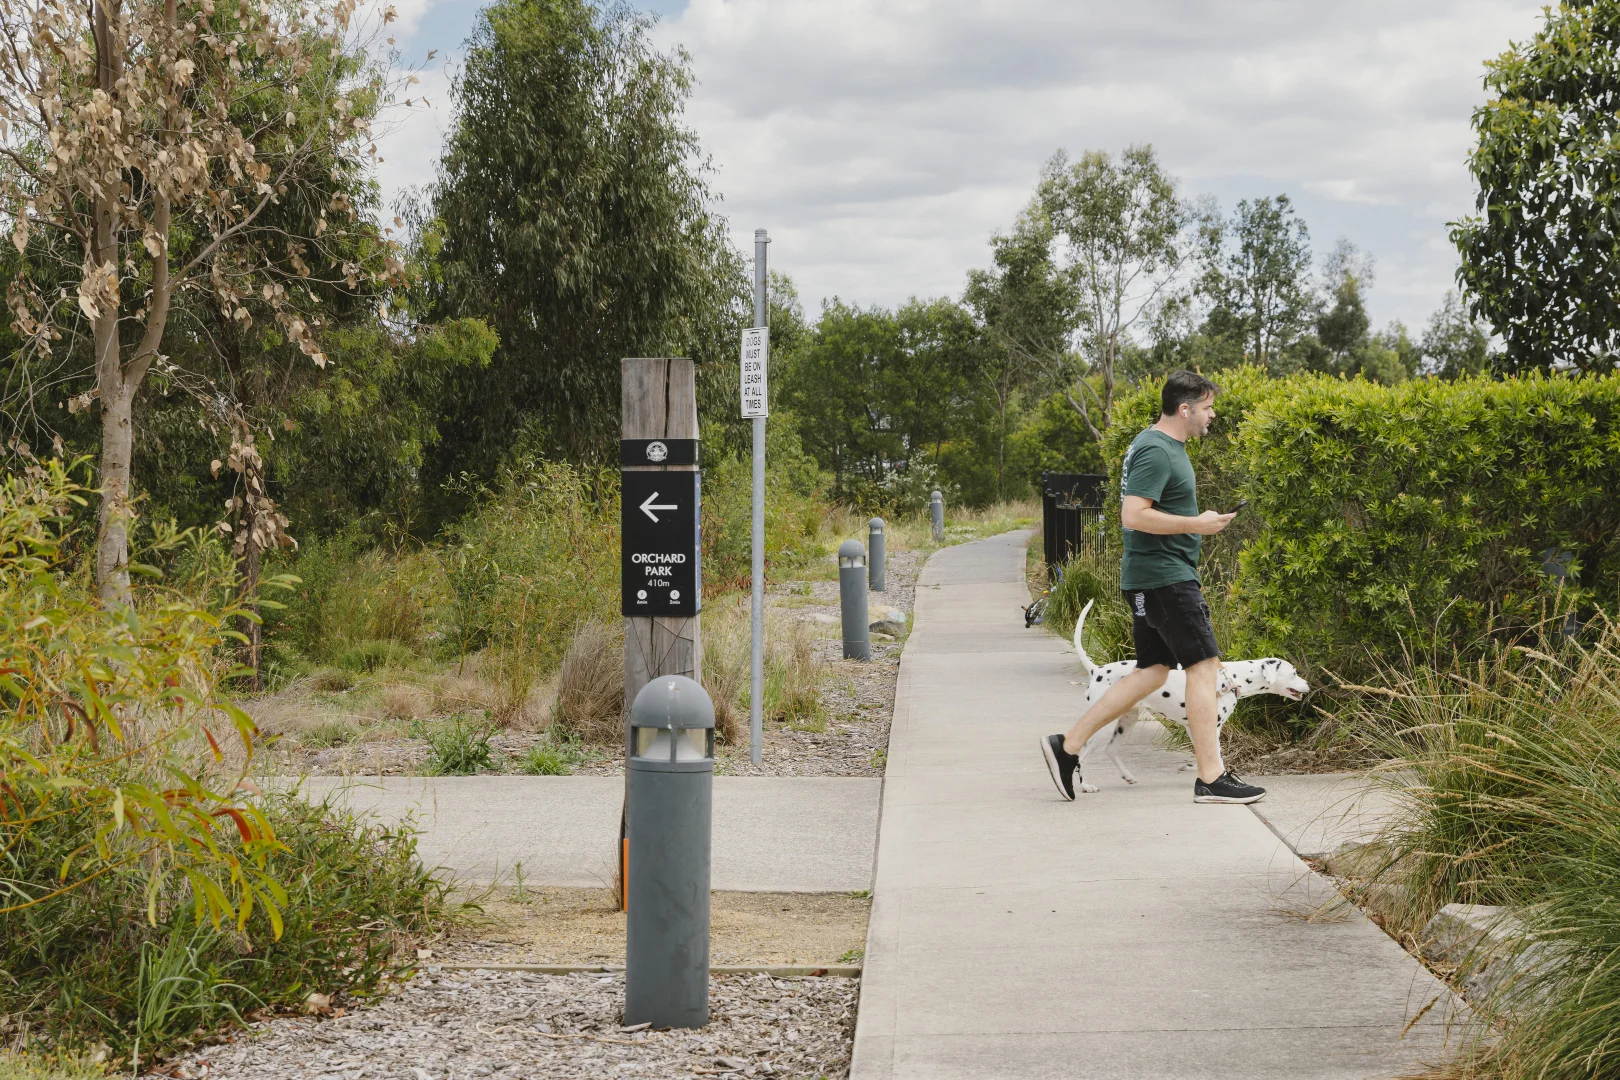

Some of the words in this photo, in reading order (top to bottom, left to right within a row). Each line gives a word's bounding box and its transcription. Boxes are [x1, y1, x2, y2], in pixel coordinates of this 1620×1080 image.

[746, 336, 761, 347] DOGS
[746, 349, 761, 359] MUST
[744, 362, 752, 372] BE
[752, 361, 760, 370] ON
[744, 374, 762, 384] LEASH
[744, 387, 750, 397] AT
[752, 387, 762, 396] ALL
[745, 399, 762, 409] TIMES
[631, 553, 686, 564] ORCHARD
[645, 566, 672, 576] PARK
[647, 579, 670, 587] 410m
